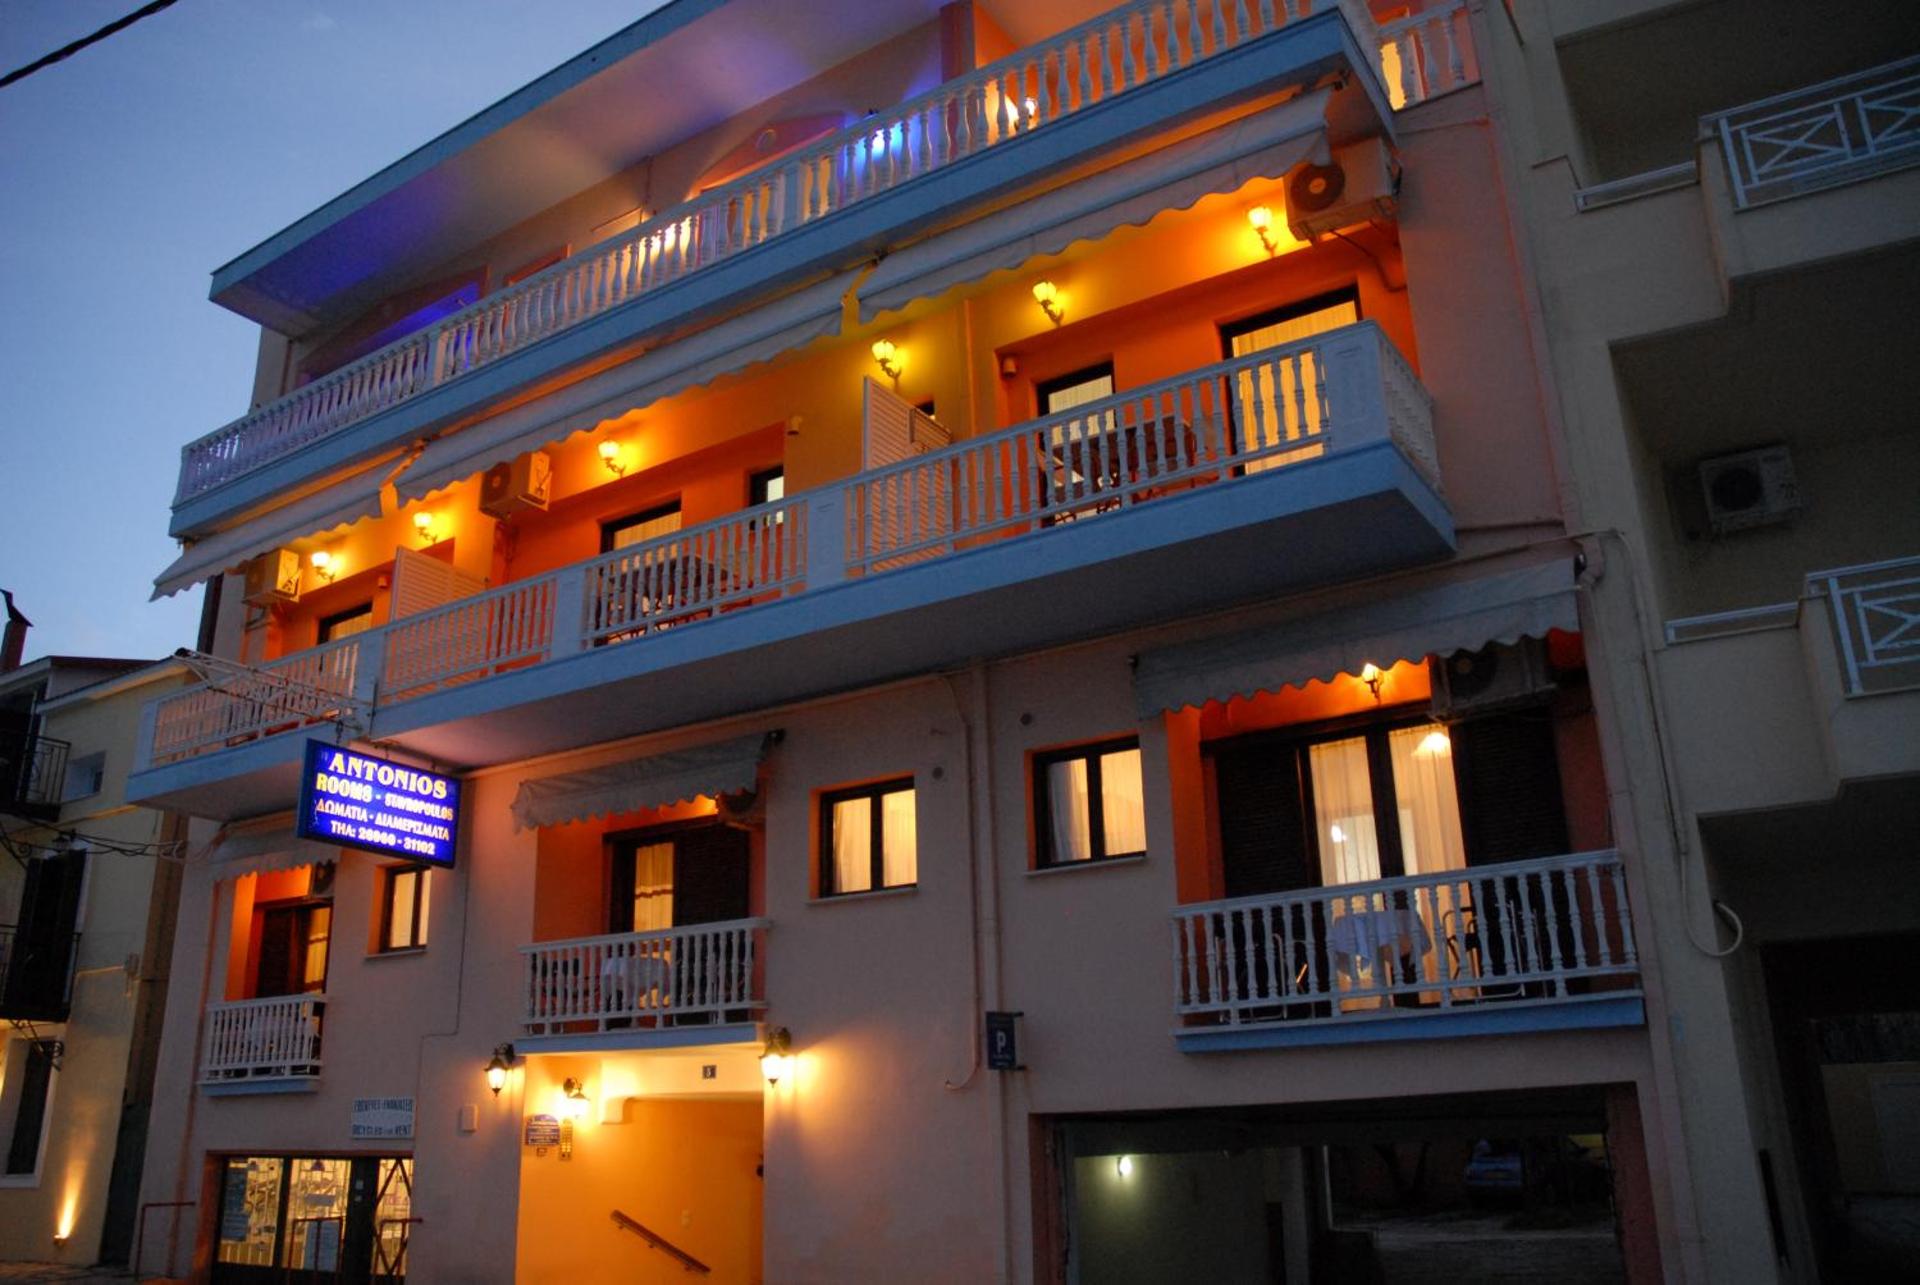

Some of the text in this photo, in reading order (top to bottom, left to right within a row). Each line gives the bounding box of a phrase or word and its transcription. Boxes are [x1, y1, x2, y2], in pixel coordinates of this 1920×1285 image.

[316, 772, 372, 803] ROOMS
[328, 753, 447, 800] ANTONIOS
[996, 1031, 1006, 1054] P
